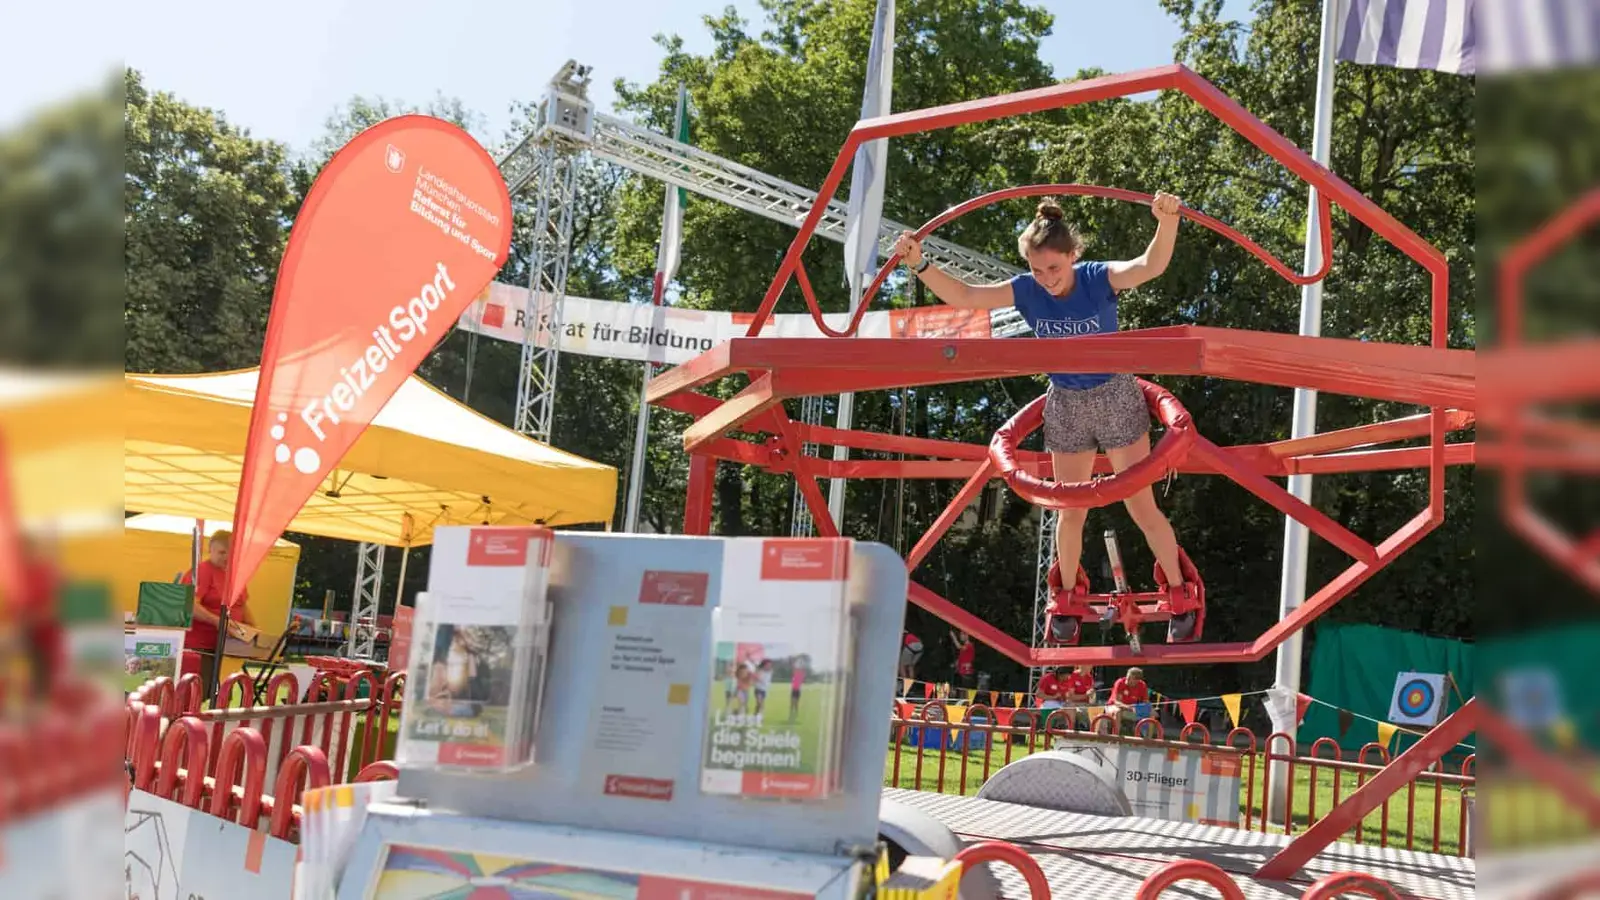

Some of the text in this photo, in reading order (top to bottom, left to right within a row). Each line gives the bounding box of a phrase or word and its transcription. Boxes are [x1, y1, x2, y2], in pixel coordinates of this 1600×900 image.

[416, 175, 461, 212] München
[418, 165, 499, 227] Landeshauptstadt
[413, 188, 467, 229] Referat für
[410, 200, 497, 261] Bildung und Sport
[514, 309, 586, 338] Rfat
[592, 322, 622, 342] für
[1035, 319, 1100, 335] PASSION
[714, 710, 764, 728] Lasst
[713, 727, 800, 749] die Spiele
[710, 746, 801, 769] beginnen!
[1126, 770, 1189, 787] 3D-Flieger
